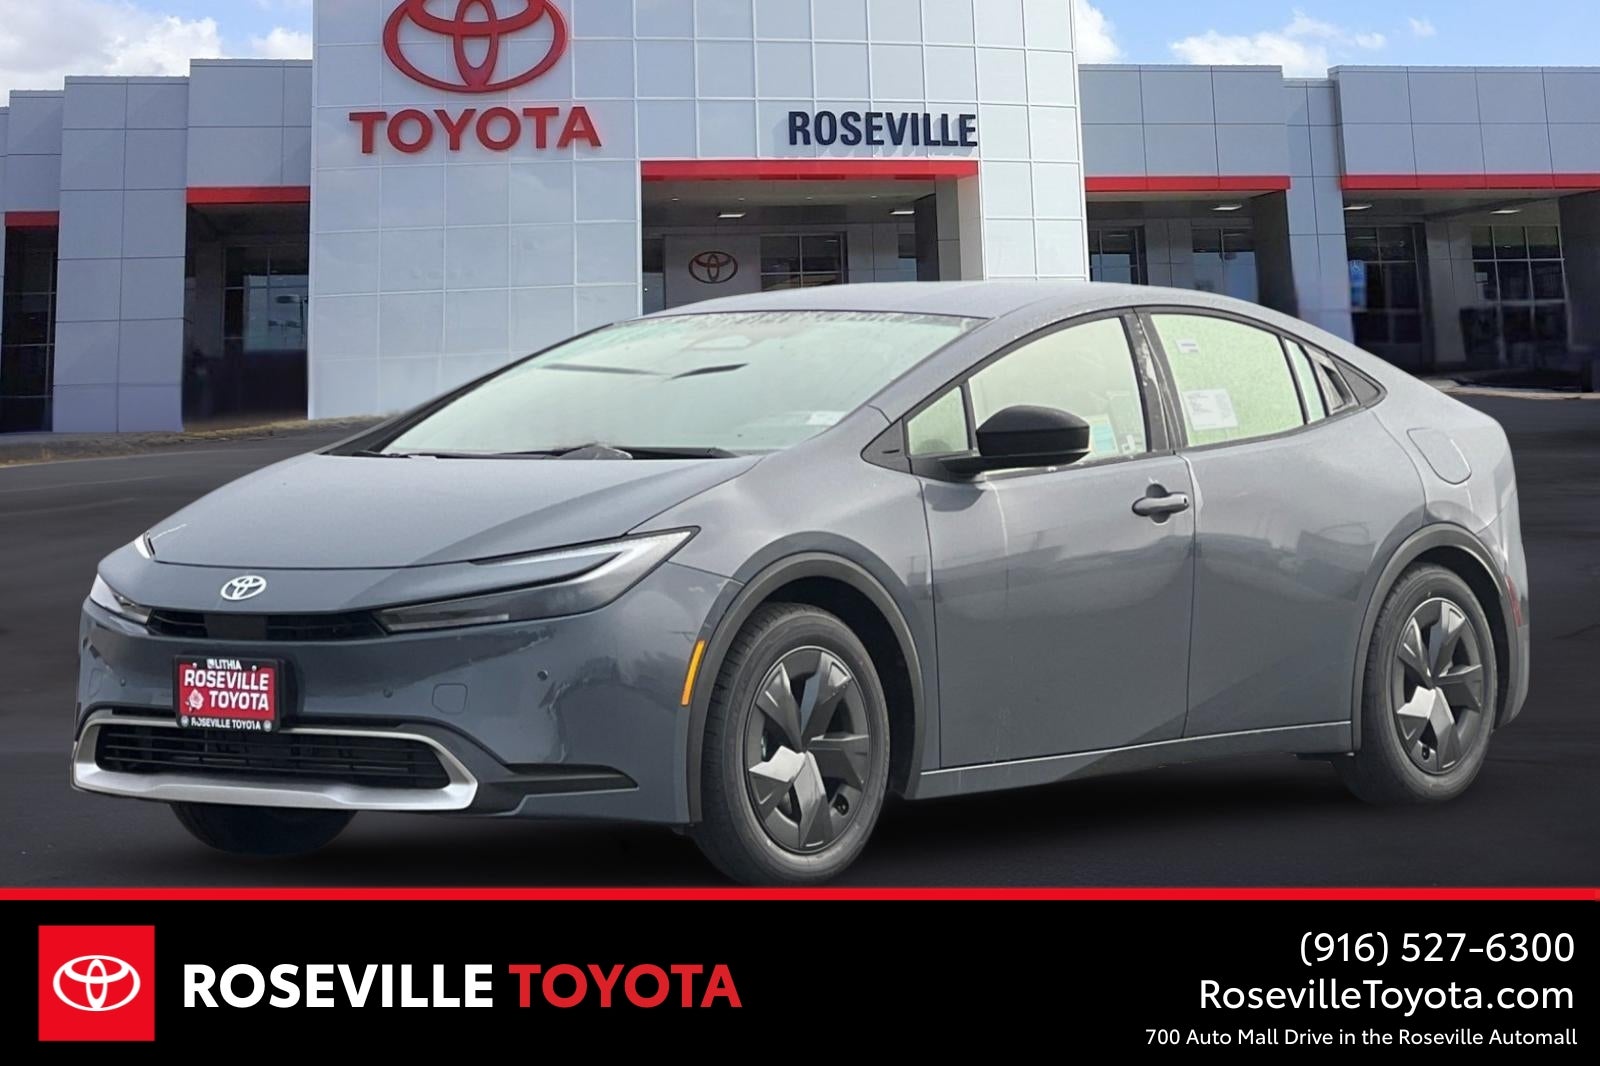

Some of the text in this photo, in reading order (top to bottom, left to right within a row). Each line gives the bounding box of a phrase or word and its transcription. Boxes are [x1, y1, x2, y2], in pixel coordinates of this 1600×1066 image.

[349, 106, 602, 154] TOYOTA
[788, 110, 978, 147] ROSEVILLE
[215, 659, 242, 670] LITHIA
[184, 669, 270, 691] ROSEVILLE
[209, 690, 269, 711] TOYOTA
[191, 717, 261, 730] ROSEVILLE TOYOTA
